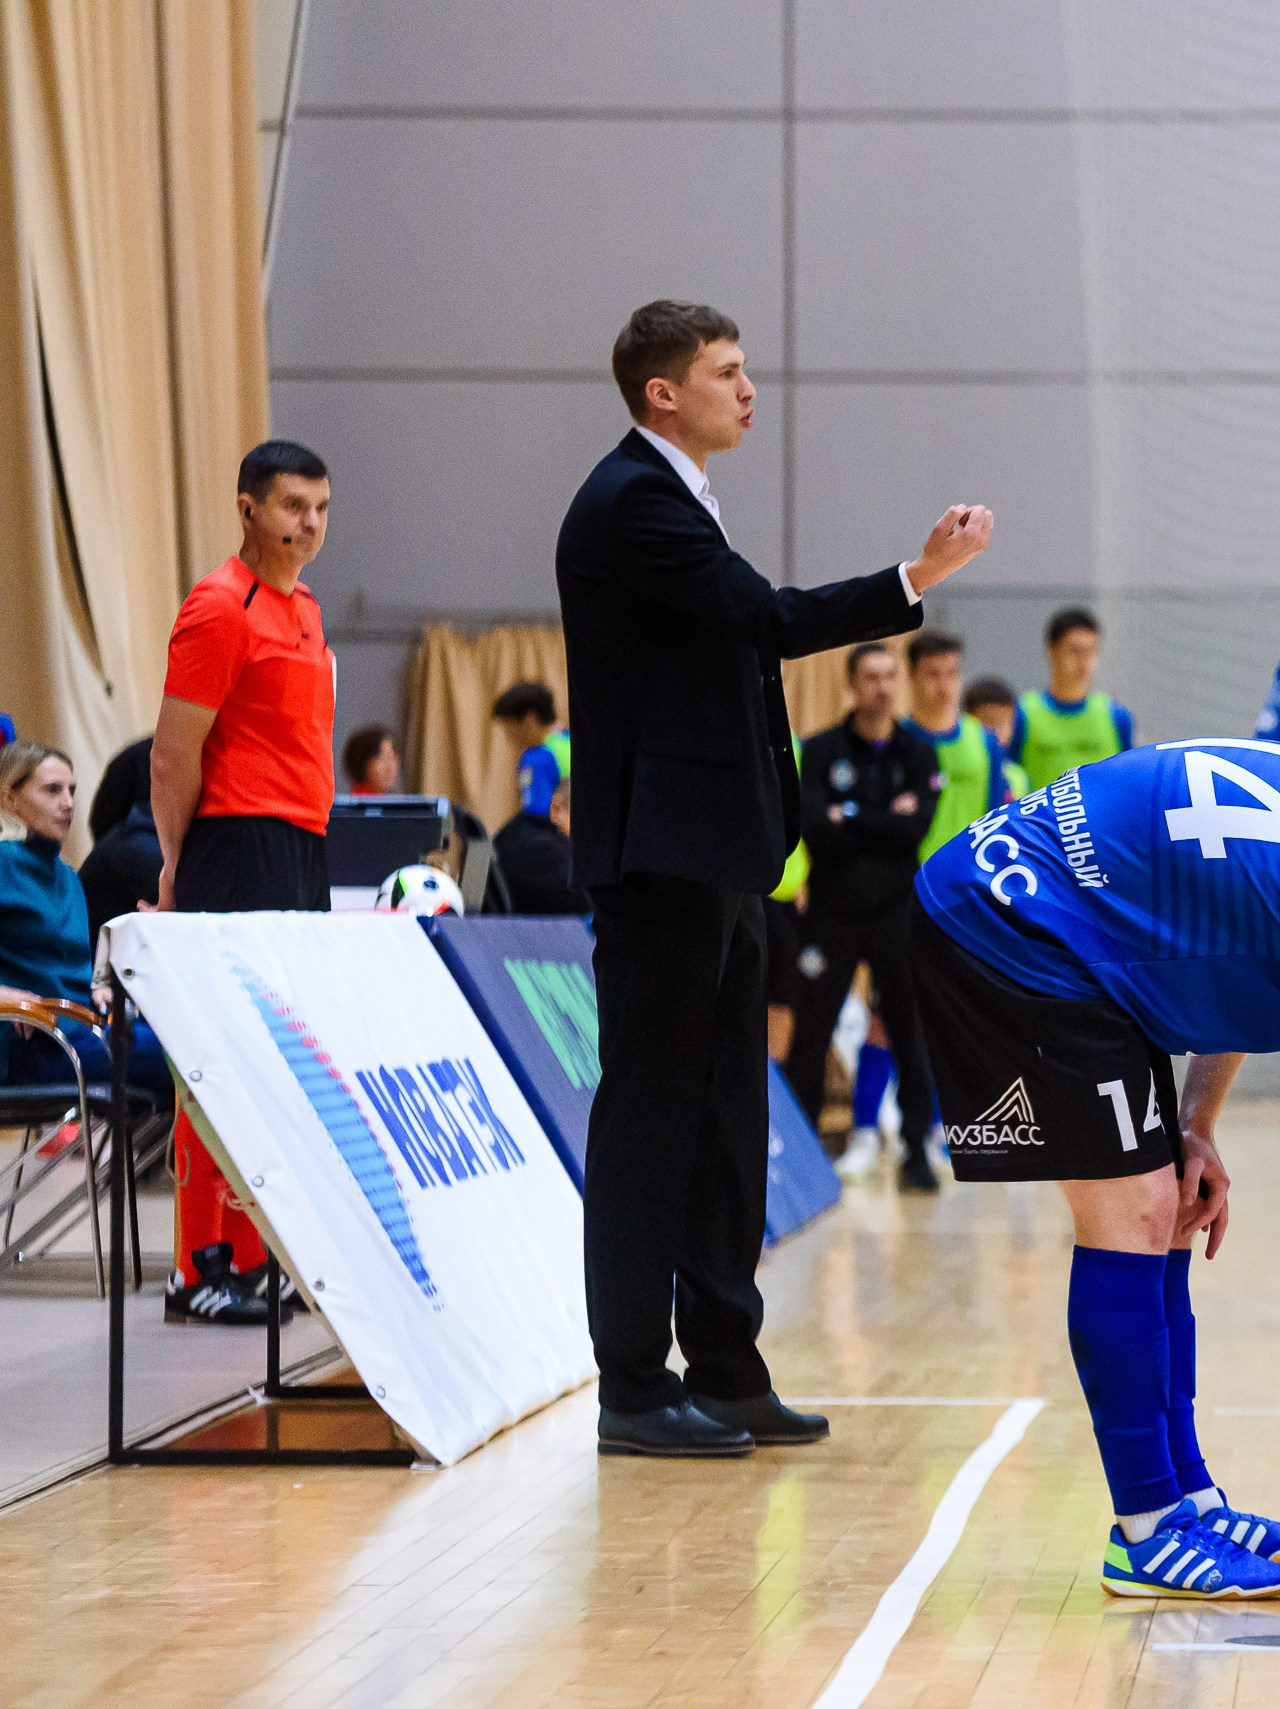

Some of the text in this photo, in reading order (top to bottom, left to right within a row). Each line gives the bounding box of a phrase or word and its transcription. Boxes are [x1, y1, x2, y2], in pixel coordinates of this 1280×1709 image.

[1050, 765, 1110, 888] ТБОЛЬНЫЙ
[355, 1057, 526, 1189] НОВАТЭК
[945, 1124, 1045, 1146] КУЗБАСС
